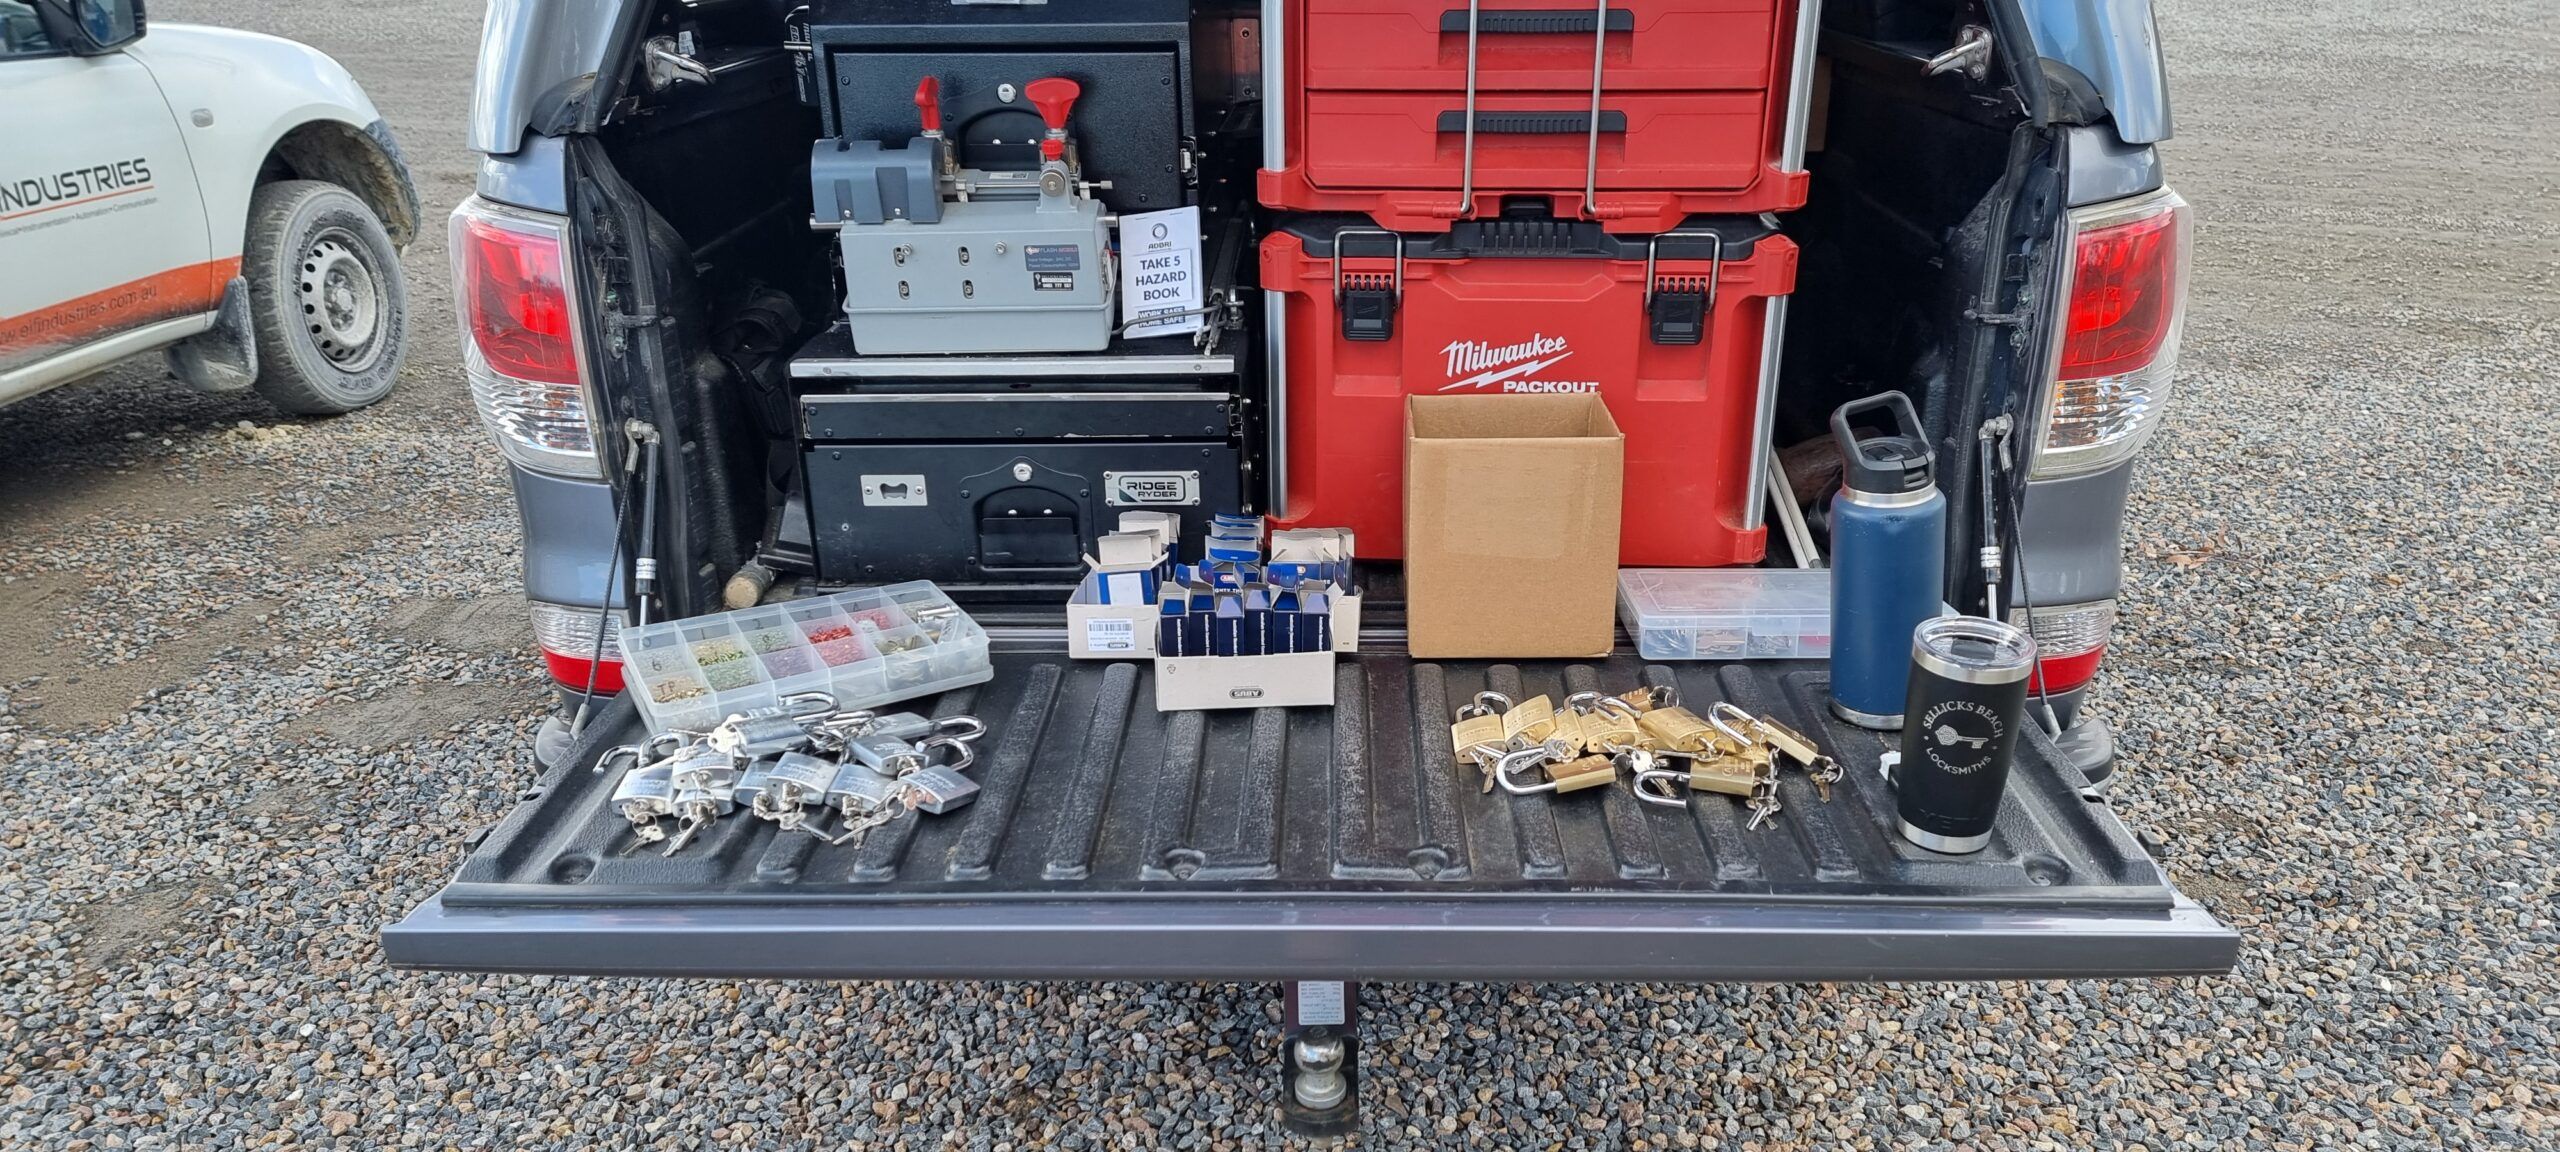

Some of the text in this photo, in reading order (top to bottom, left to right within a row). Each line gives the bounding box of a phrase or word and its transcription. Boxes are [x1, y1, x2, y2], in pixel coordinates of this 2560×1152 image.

[1140, 255, 1181, 270] TAKE 5
[1135, 270, 1187, 286] HAZARD
[1143, 287, 1180, 301] BOOK
[1439, 333, 1568, 377] Milwaukee
[1503, 381, 1599, 393] PACKOUT
[1126, 482, 1177, 490] RIDGE
[1923, 701, 2003, 738] SELLICKS BEACH
[1926, 747, 1991, 775] LOCKSMITHS
